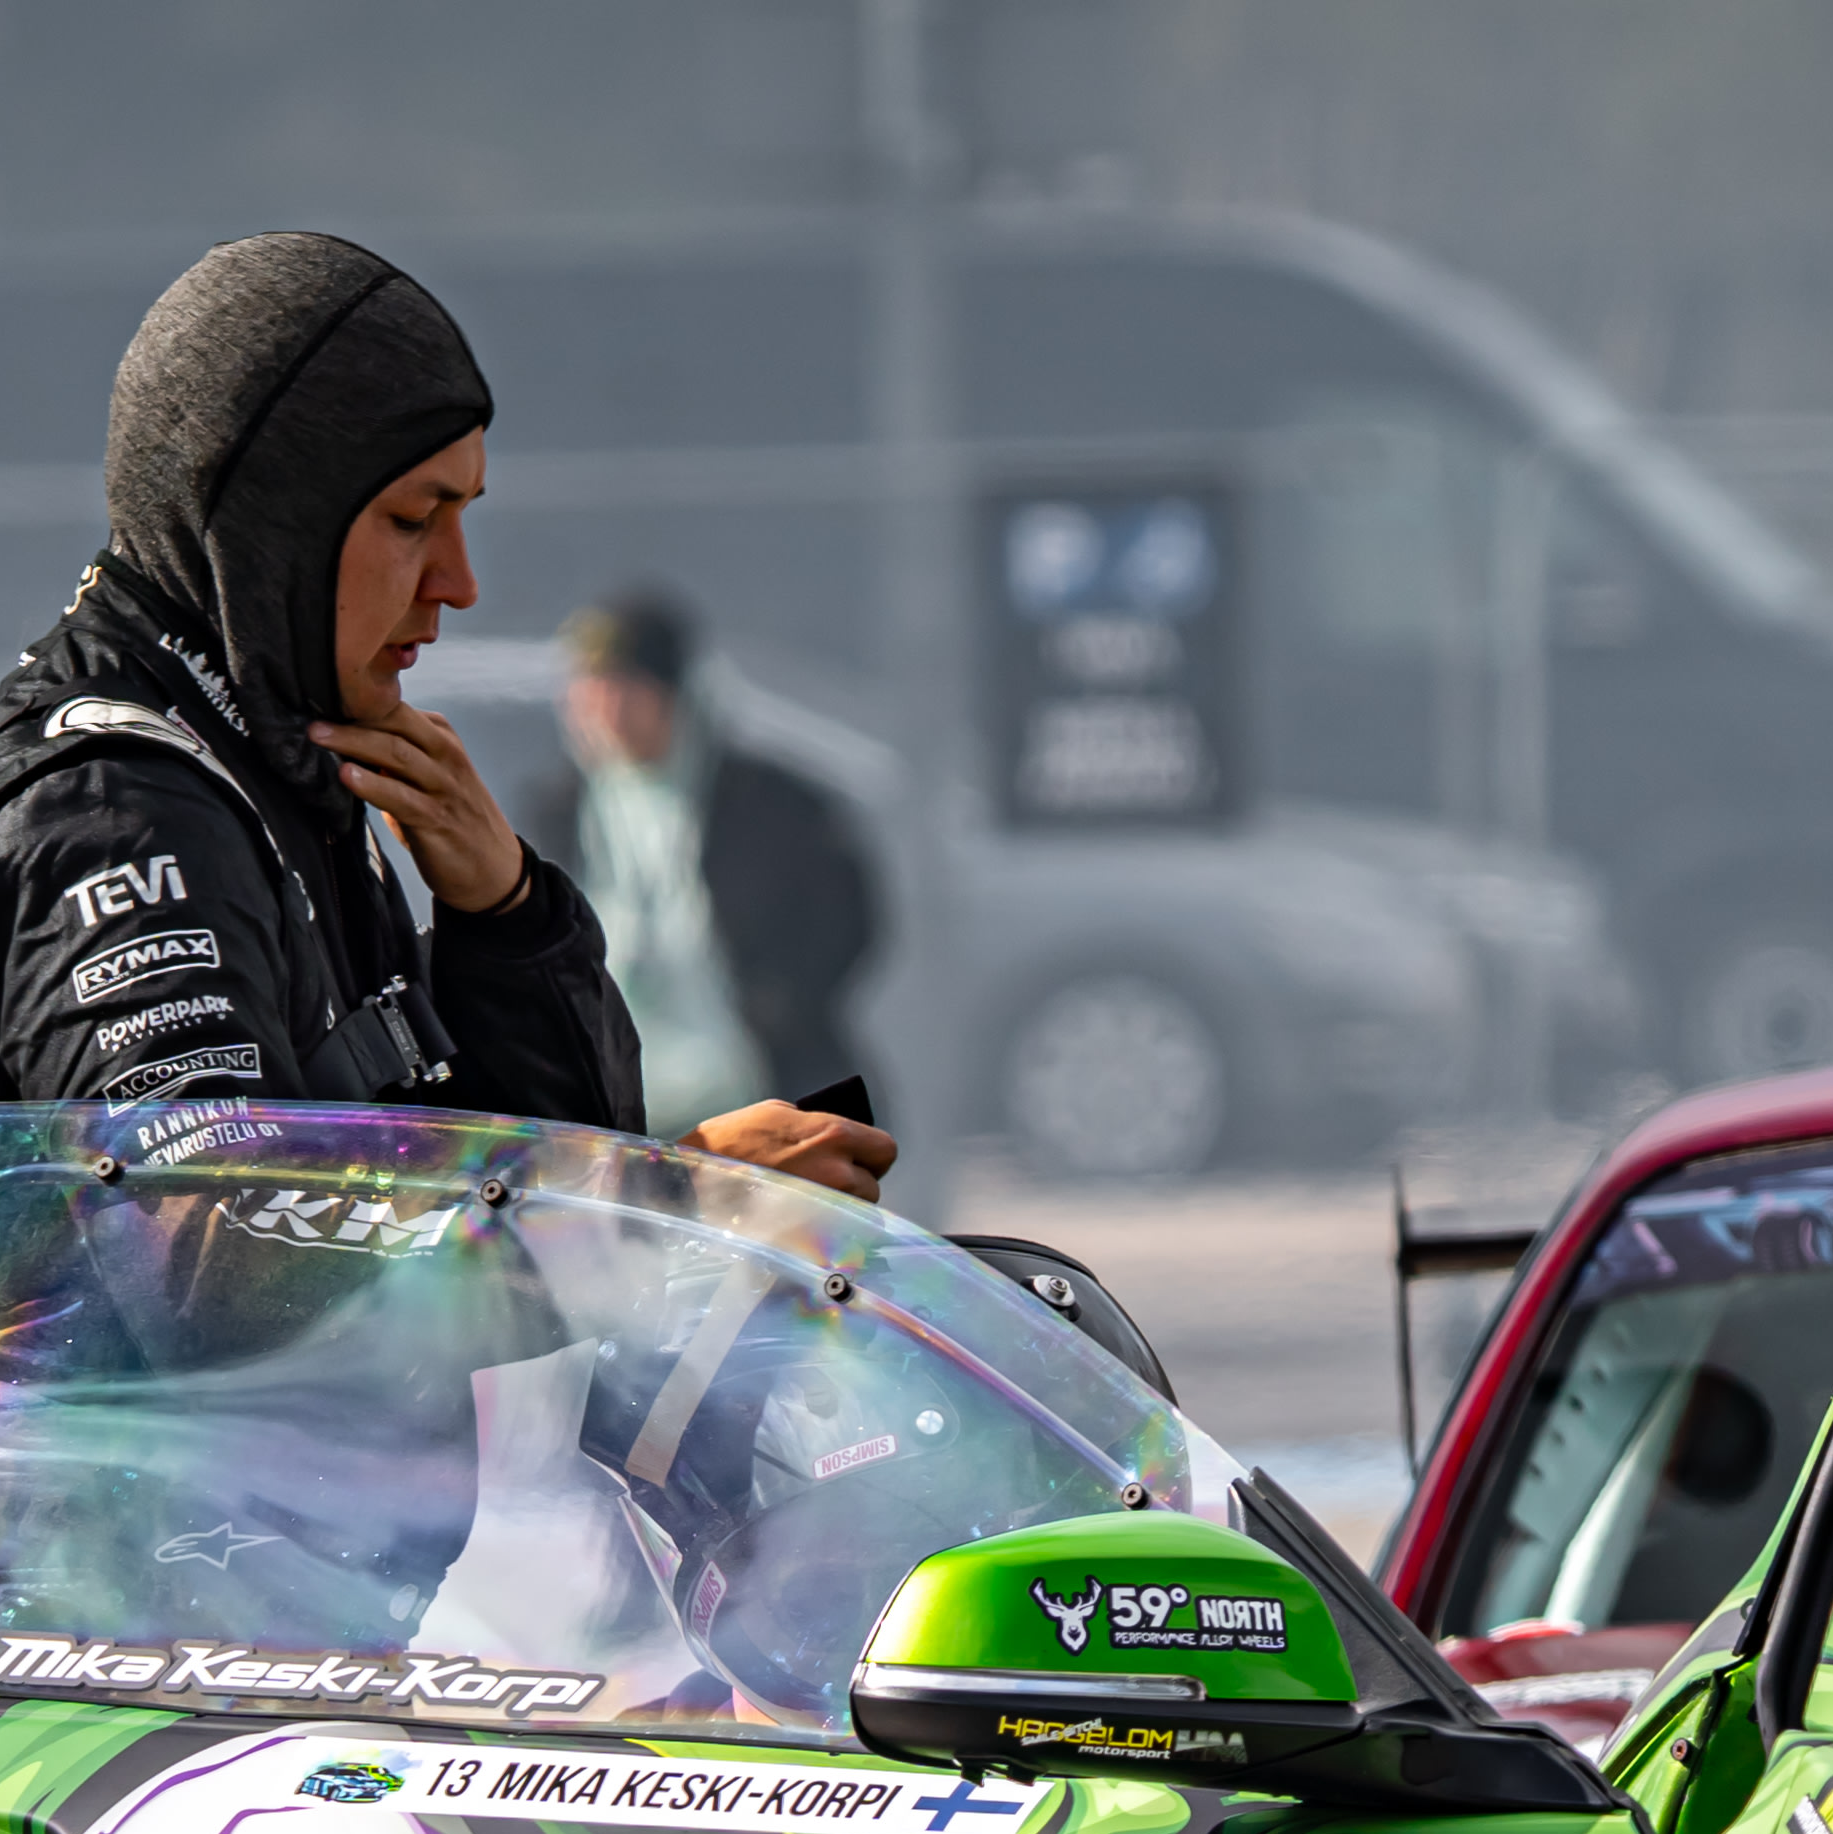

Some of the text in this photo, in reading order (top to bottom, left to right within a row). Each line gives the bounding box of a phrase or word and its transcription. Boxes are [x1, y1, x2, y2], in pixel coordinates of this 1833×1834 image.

[77, 936, 216, 992] RYMAX
[96, 994, 236, 1052] POWERPARK
[120, 1050, 256, 1100] ACCOUNTING
[257, 1122, 284, 1138] OY
[817, 1437, 889, 1475] SIMPSON
[693, 1570, 721, 1636] SIMPS
[1199, 1599, 1285, 1631] NORTH
[1115, 1631, 1285, 1649] PERFORMANCE ALLOY WHEELS
[167, 1647, 599, 1710] Keski-Korpi
[1078, 1744, 1170, 1759] motorsport
[426, 1759, 903, 1820] 13 MIKA KESKI-KORPI
